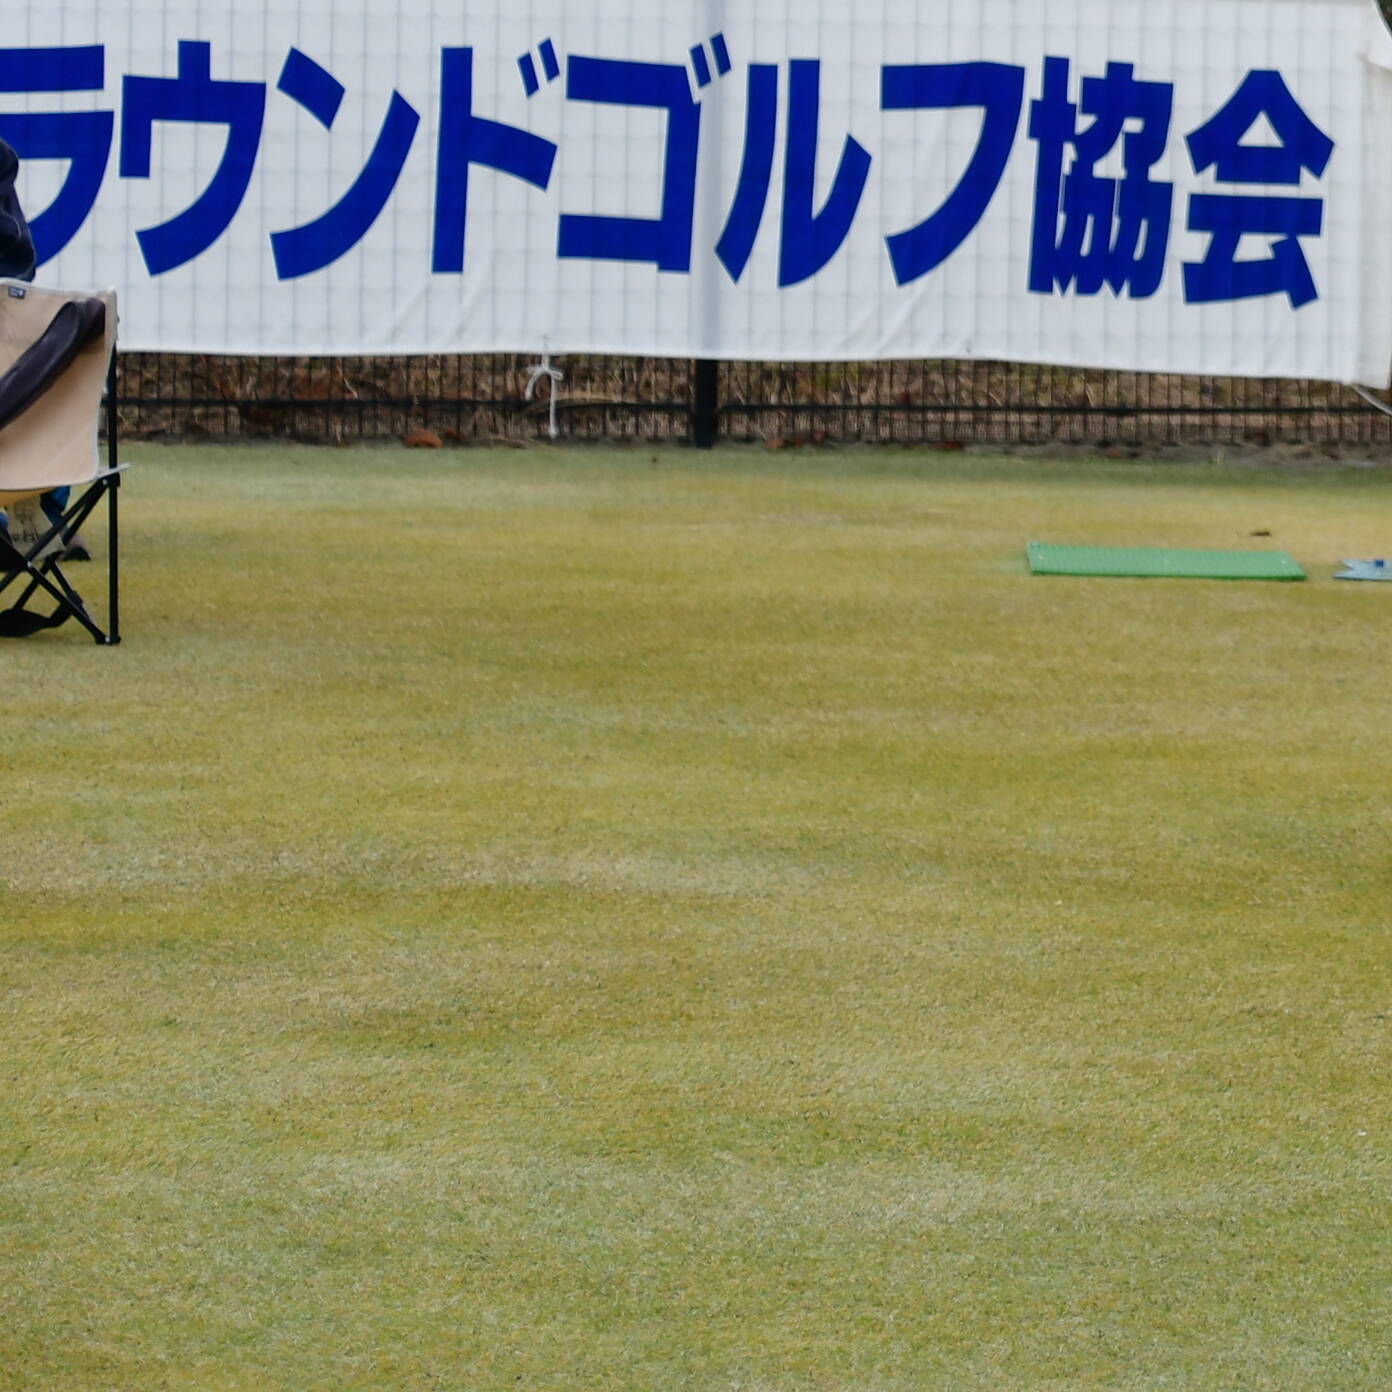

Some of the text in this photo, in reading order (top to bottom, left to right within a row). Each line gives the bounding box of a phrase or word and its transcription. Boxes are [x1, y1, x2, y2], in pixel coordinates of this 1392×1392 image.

[0, 33, 1334, 310] ラウンドゴルフ協会
